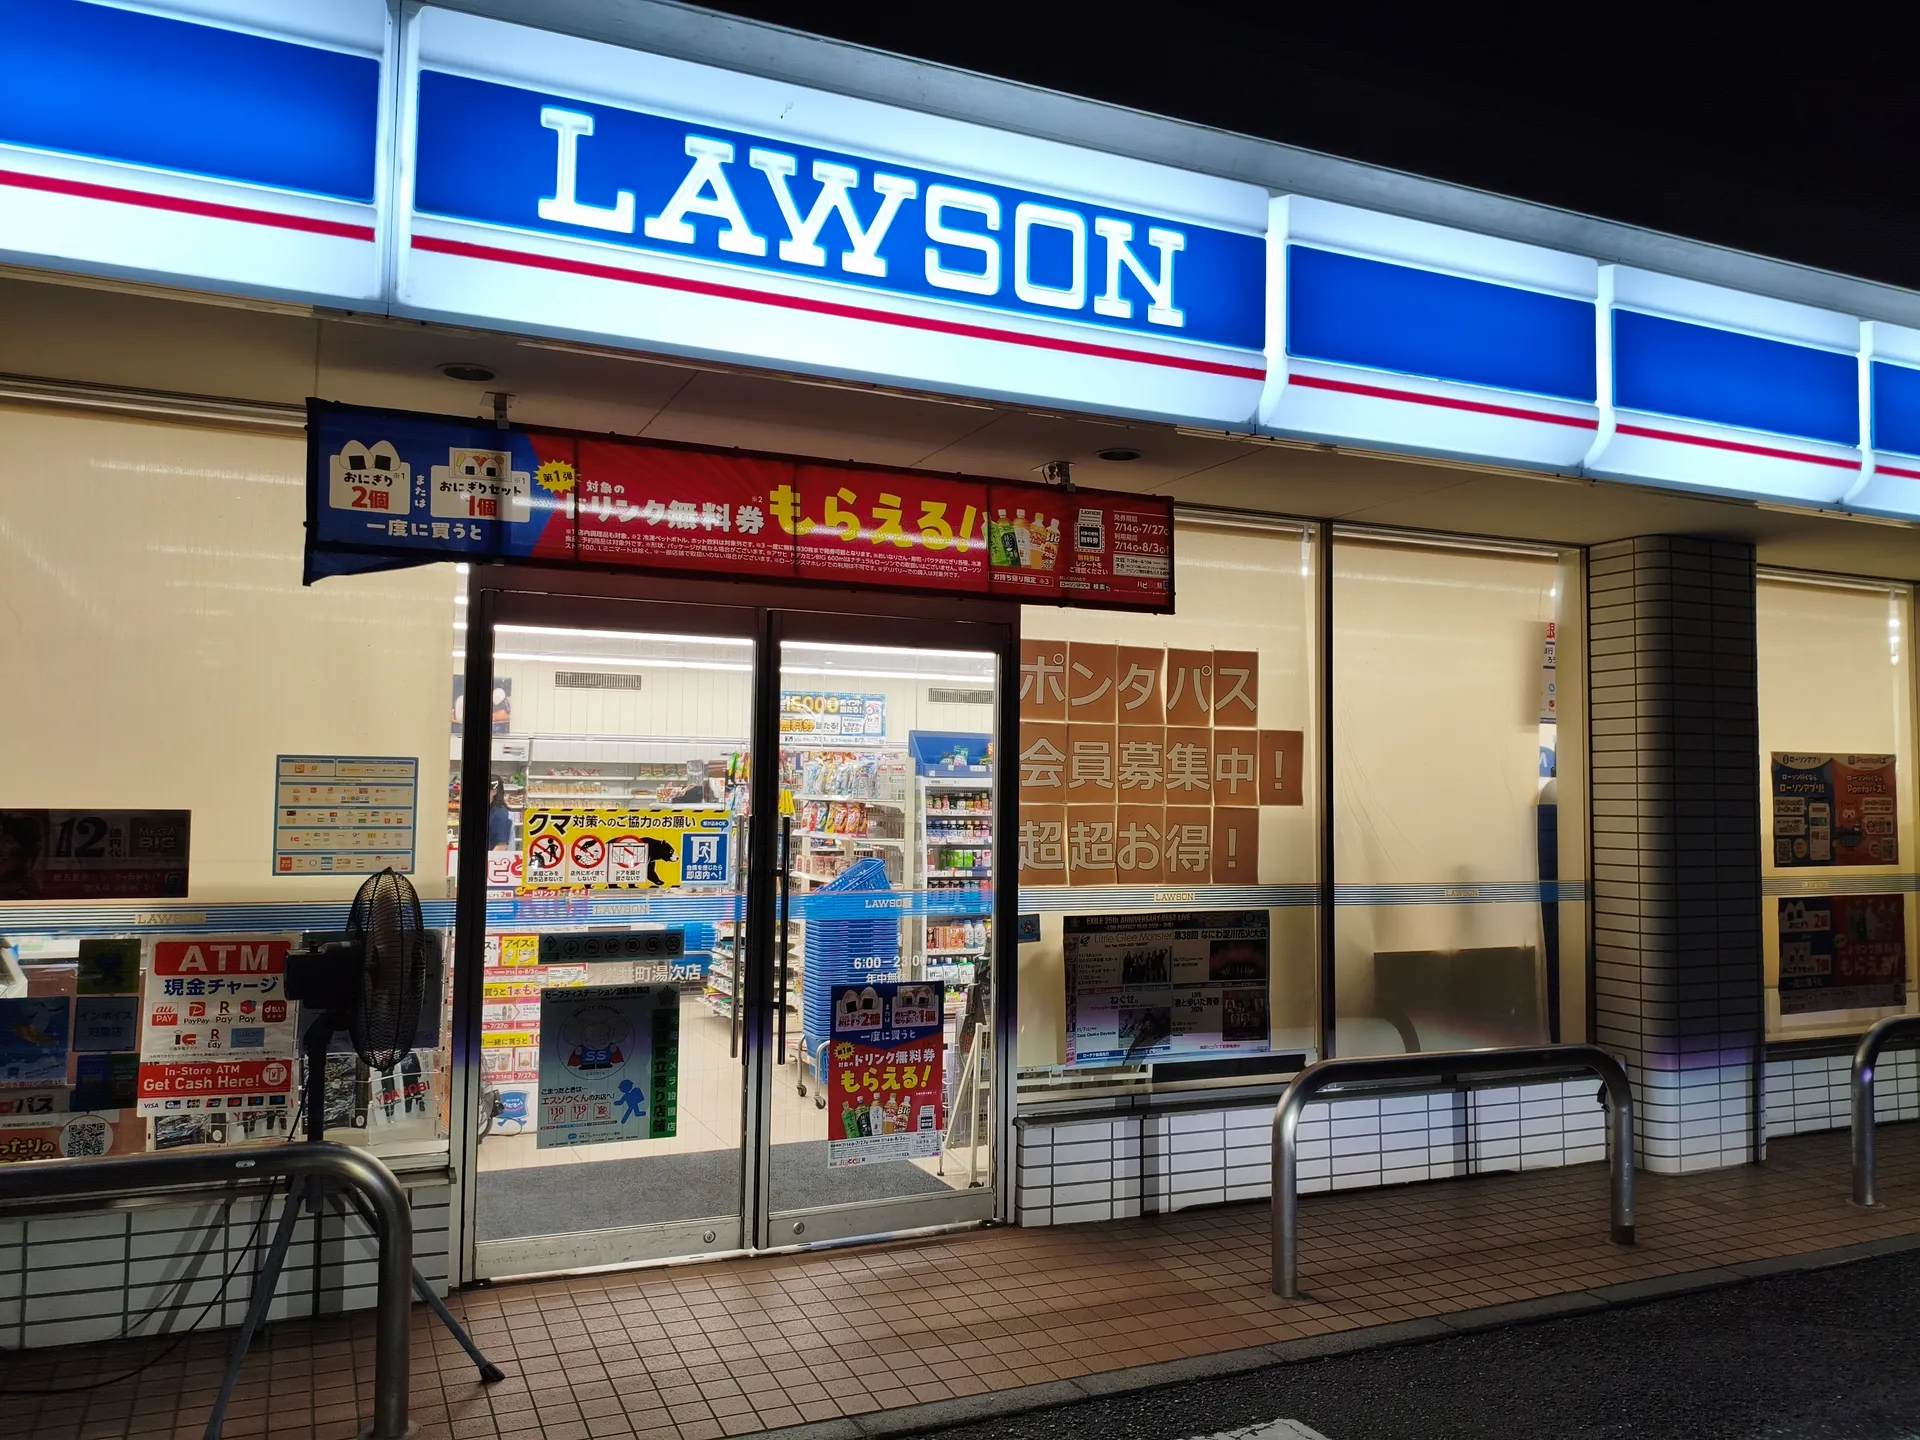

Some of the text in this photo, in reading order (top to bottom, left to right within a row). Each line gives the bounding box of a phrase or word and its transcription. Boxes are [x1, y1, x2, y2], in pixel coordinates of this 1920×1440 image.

[537, 106, 1187, 328] LAWSON
[343, 472, 393, 487] おにぎり
[543, 470, 573, 483] 第1弾
[415, 474, 427, 508] または
[439, 481, 522, 496] おにぎりセット
[586, 480, 625, 495] 対象の
[351, 486, 390, 510] 2個
[466, 495, 498, 518] 1個
[565, 492, 765, 535] ドリンク無料券
[769, 483, 977, 553] もらえる！
[366, 519, 482, 541] 一度に買うと
[1075, 561, 1103, 569] レシートを
[1069, 567, 1109, 576] ご確認ください
[993, 573, 1037, 585] お持ち帰り限定
[1020, 652, 1258, 713] ポンタパス
[780, 718, 816, 732] 無料券
[1019, 736, 1285, 796] 会員募集中！
[1789, 756, 1821, 764] ローソンアプリ
[1856, 756, 1887, 764] Pontaパス
[55, 816, 108, 858] 12
[139, 826, 177, 837] MEGA
[139, 837, 177, 849] BIG
[1018, 820, 1238, 874] 超超お得！
[686, 870, 722, 880] 即店内へ！
[1155, 892, 1195, 901] LAWSON
[1446, 889, 1478, 897] LAWSON
[594, 904, 649, 915] LAWSON
[864, 898, 913, 909] LAWSON
[137, 913, 204, 925] LAWSON
[1086, 917, 1103, 925] EXILE
[1104, 916, 1119, 924] 25th
[1119, 914, 1160, 924] ANNIVERSARY
[1178, 913, 1191, 921] LIVE
[1094, 931, 1173, 943] Little Glee Monster
[1174, 928, 1267, 940] 第38回 なにわ淀川花火大会
[504, 939, 530, 949] アイス
[178, 944, 269, 973] ATM
[865, 972, 909, 984] 年中無休
[163, 977, 280, 997] 現金チャージ
[1110, 994, 1139, 1004] ねぐせ。
[1174, 998, 1220, 1008] 君と歩いた青春
[155, 1005, 176, 1013] au
[220, 1000, 230, 1013] R
[79, 1011, 133, 1022] インボイス
[156, 1014, 174, 1023] PAY
[215, 1016, 233, 1025] Pay
[238, 1015, 256, 1024] Pay
[860, 1012, 881, 1027] 2個
[918, 1009, 936, 1023] 1個
[210, 1028, 220, 1040] R
[860, 1029, 917, 1043] 一度に買うと
[207, 1041, 222, 1049] Edy
[585, 1050, 607, 1062] SS
[164, 1065, 240, 1077] In-Store ATM
[653, 1015, 668, 1133] 官立寄り店舗
[143, 1074, 259, 1091] Get Cash Here!
[840, 1065, 933, 1094] もらえる！
[549, 1103, 587, 1116] 110 119
